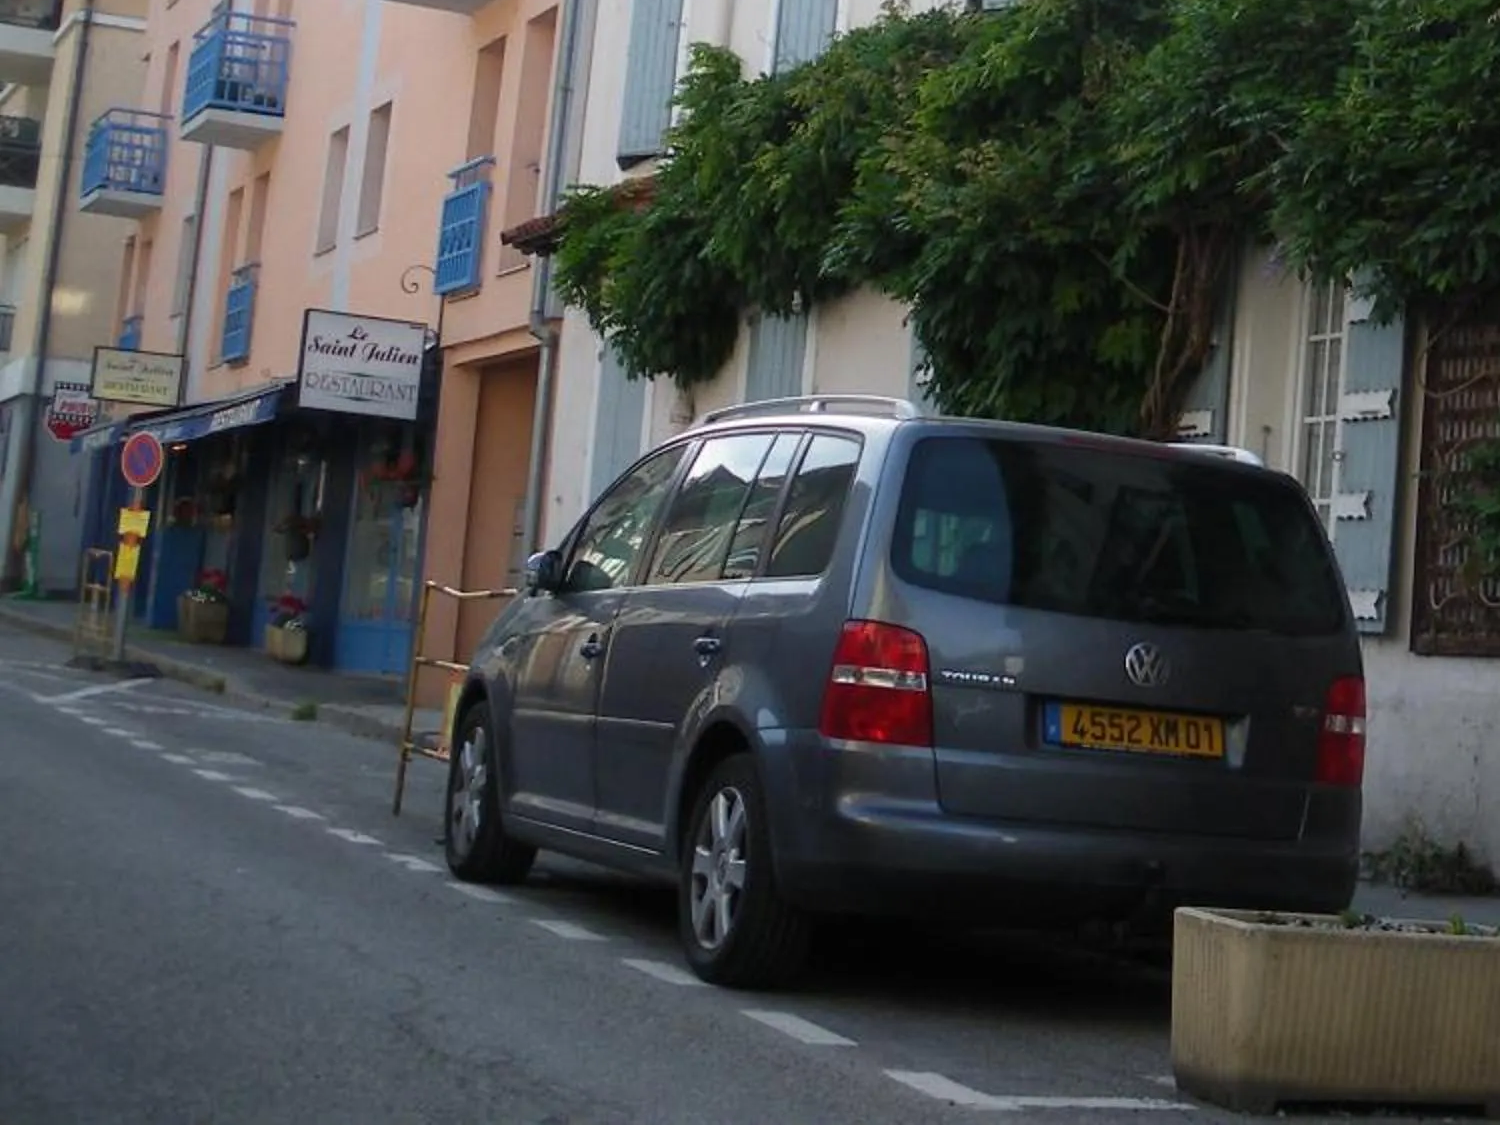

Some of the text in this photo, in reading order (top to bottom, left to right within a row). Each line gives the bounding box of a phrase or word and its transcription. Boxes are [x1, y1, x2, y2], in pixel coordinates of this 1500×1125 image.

[346, 324, 369, 341] Le
[307, 335, 419, 365] Saint Julien
[304, 372, 417, 403] RESTAURANT
[1071, 709, 1215, 752] 4552 XM 01
